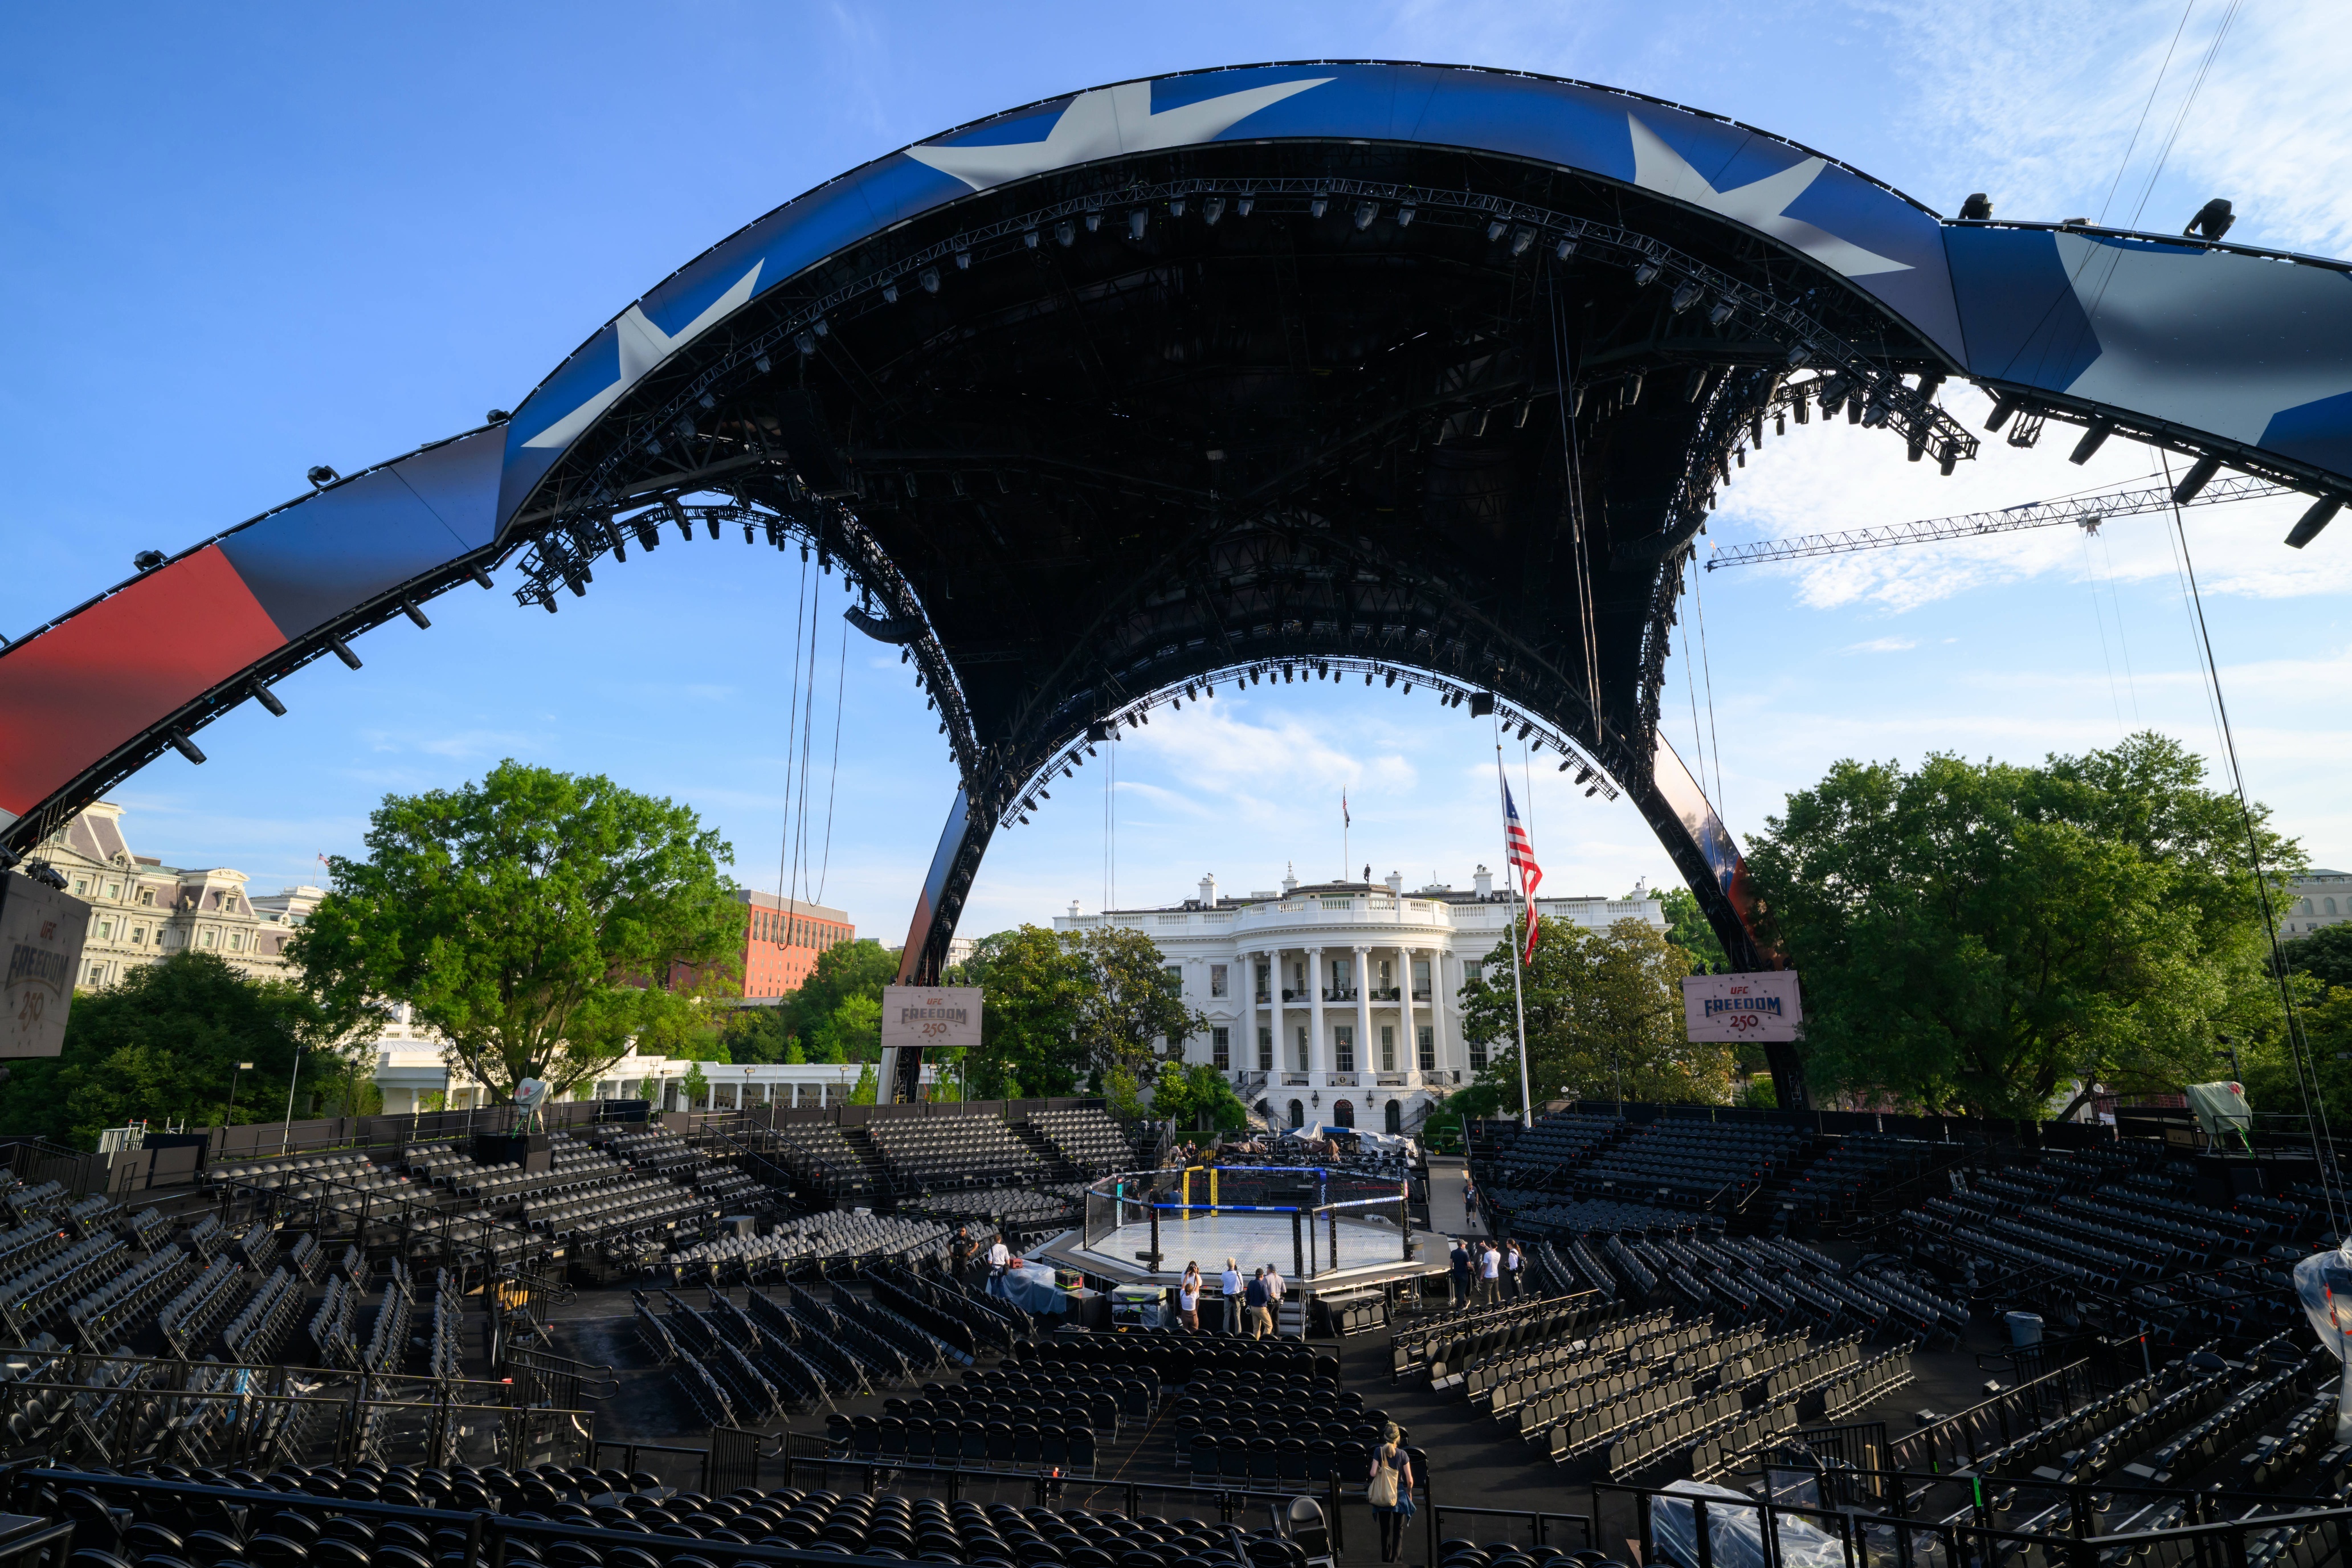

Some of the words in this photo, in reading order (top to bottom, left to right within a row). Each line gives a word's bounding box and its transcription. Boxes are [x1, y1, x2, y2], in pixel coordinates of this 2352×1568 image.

[40, 920, 57, 941] UFC
[4, 943, 70, 1000] FREEDOM
[18, 991, 44, 1032] 250
[901, 1008, 967, 1025] FREEDOM
[1704, 997, 1782, 1018] FREEDOM
[922, 1023, 947, 1038] 250
[1730, 1014, 1758, 1032] 250
